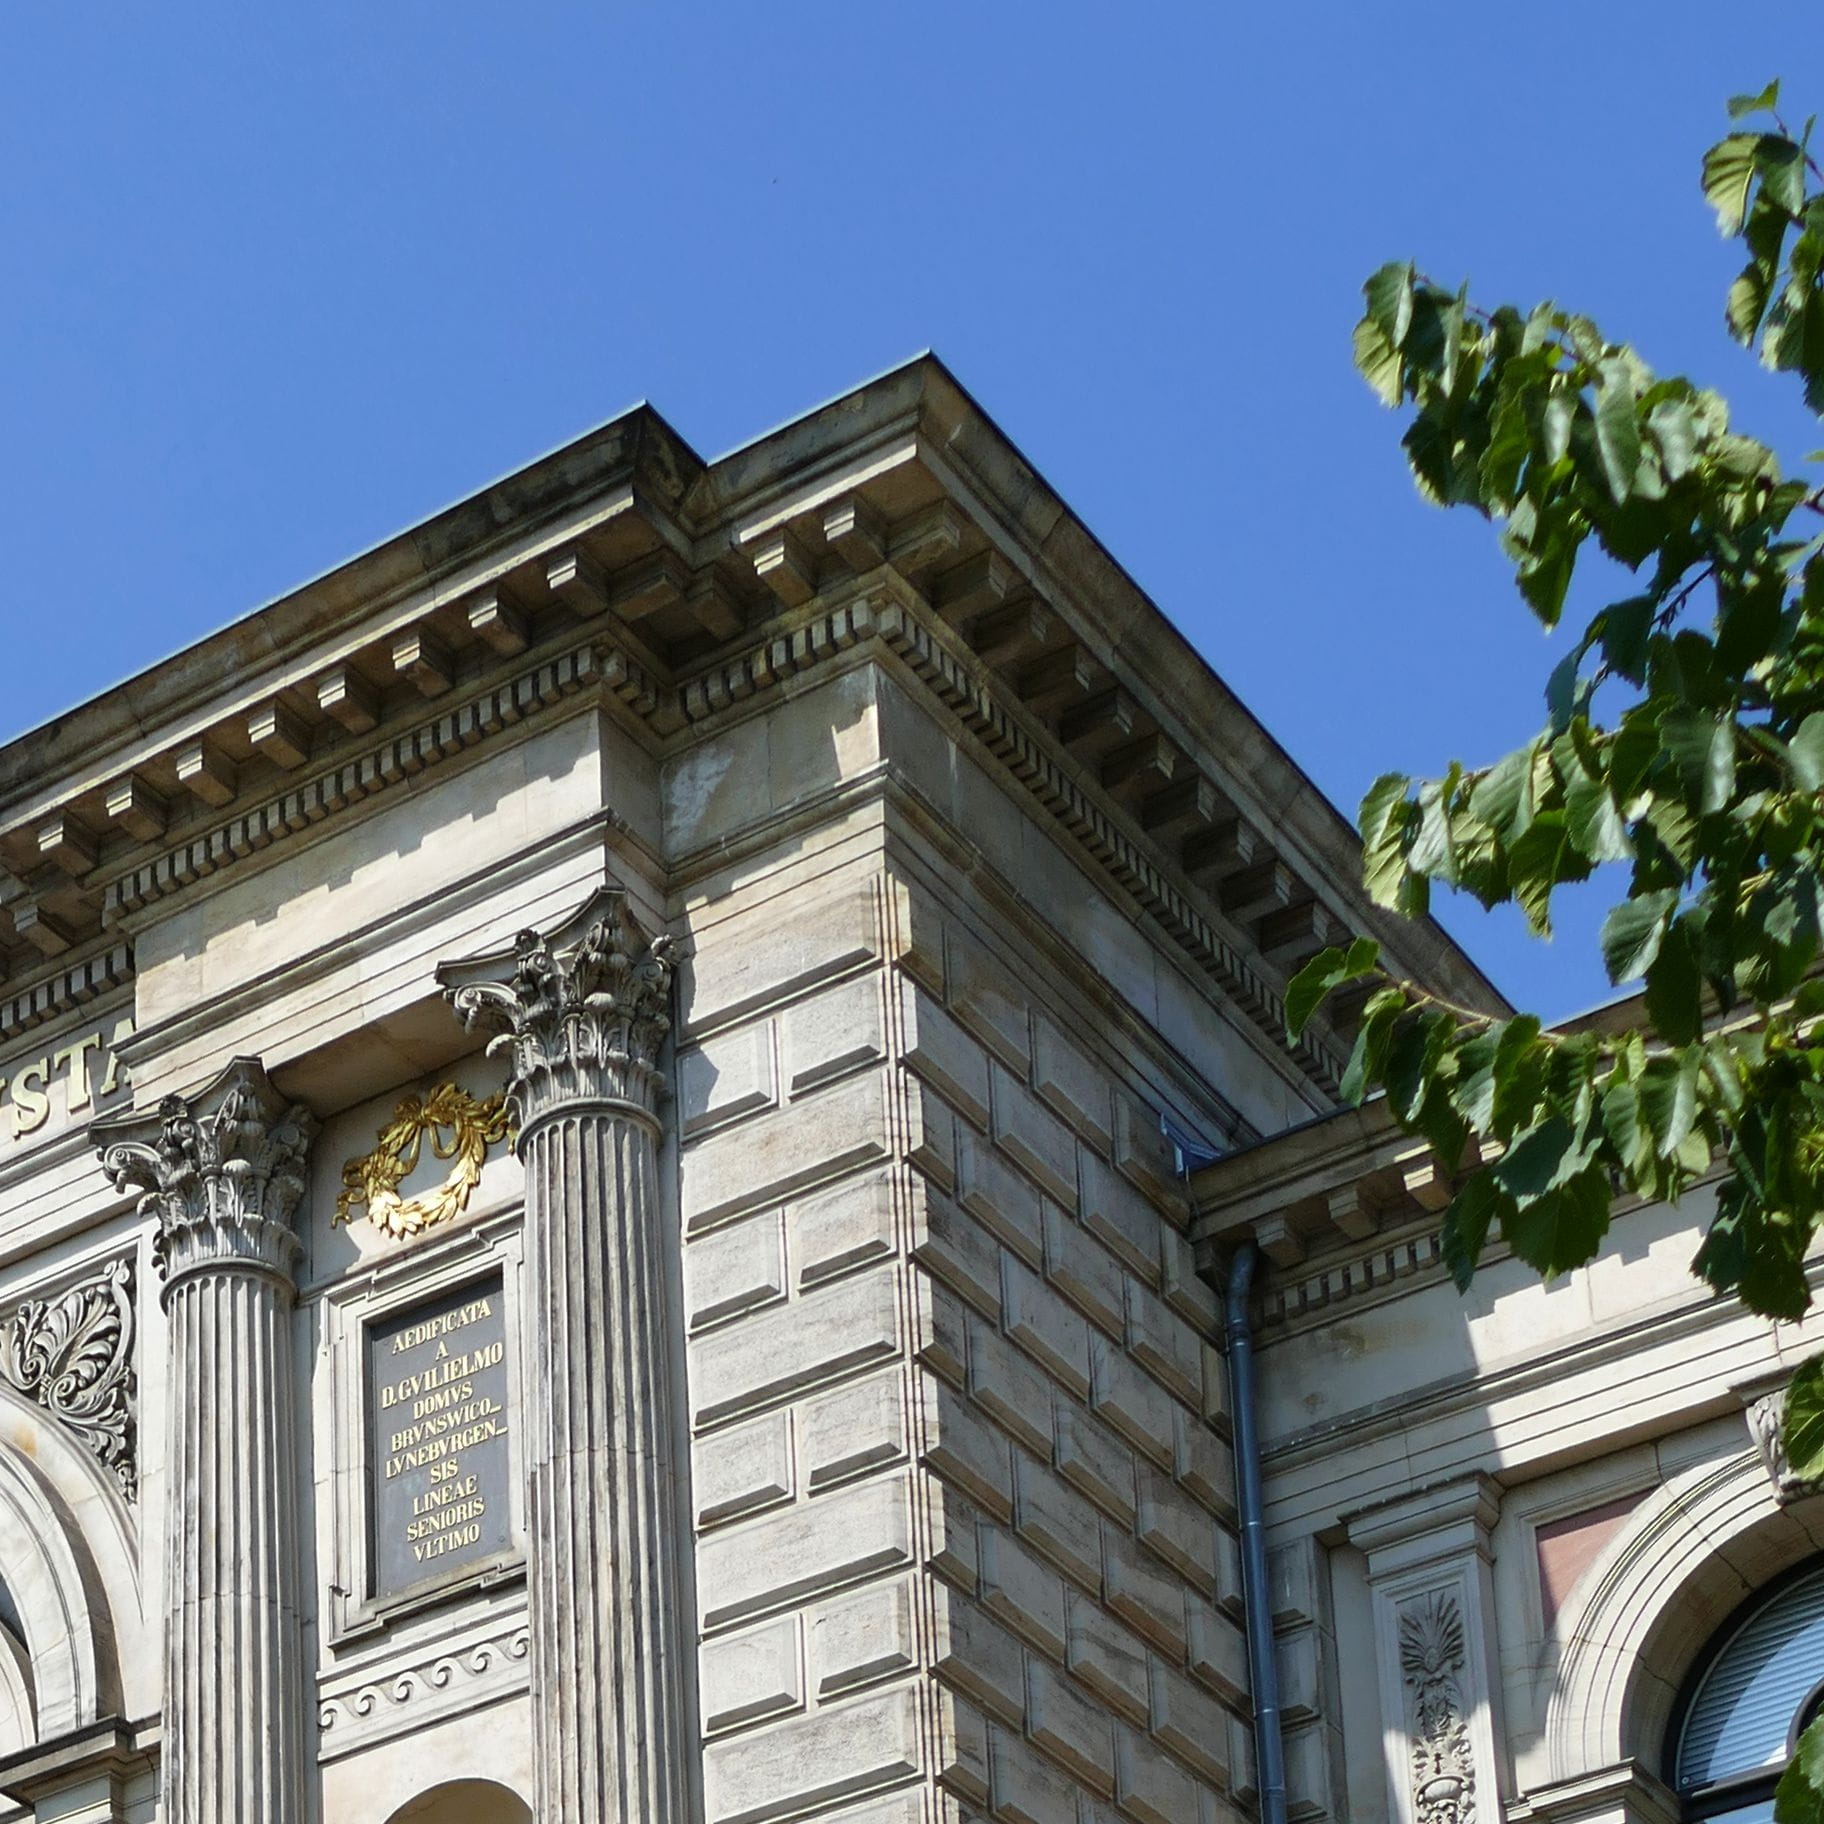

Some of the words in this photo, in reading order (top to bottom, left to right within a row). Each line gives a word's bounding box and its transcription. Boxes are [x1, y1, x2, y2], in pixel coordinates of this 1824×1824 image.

[392, 1299, 492, 1355] AEDIFICATA
[435, 1340, 449, 1361] A
[413, 1381, 473, 1420] DOMVS
[430, 1458, 459, 1485] SIS
[413, 1474, 478, 1517] LINEAE
[407, 1497, 485, 1543] SENIORIS
[413, 1524, 480, 1563] VLTIMO
